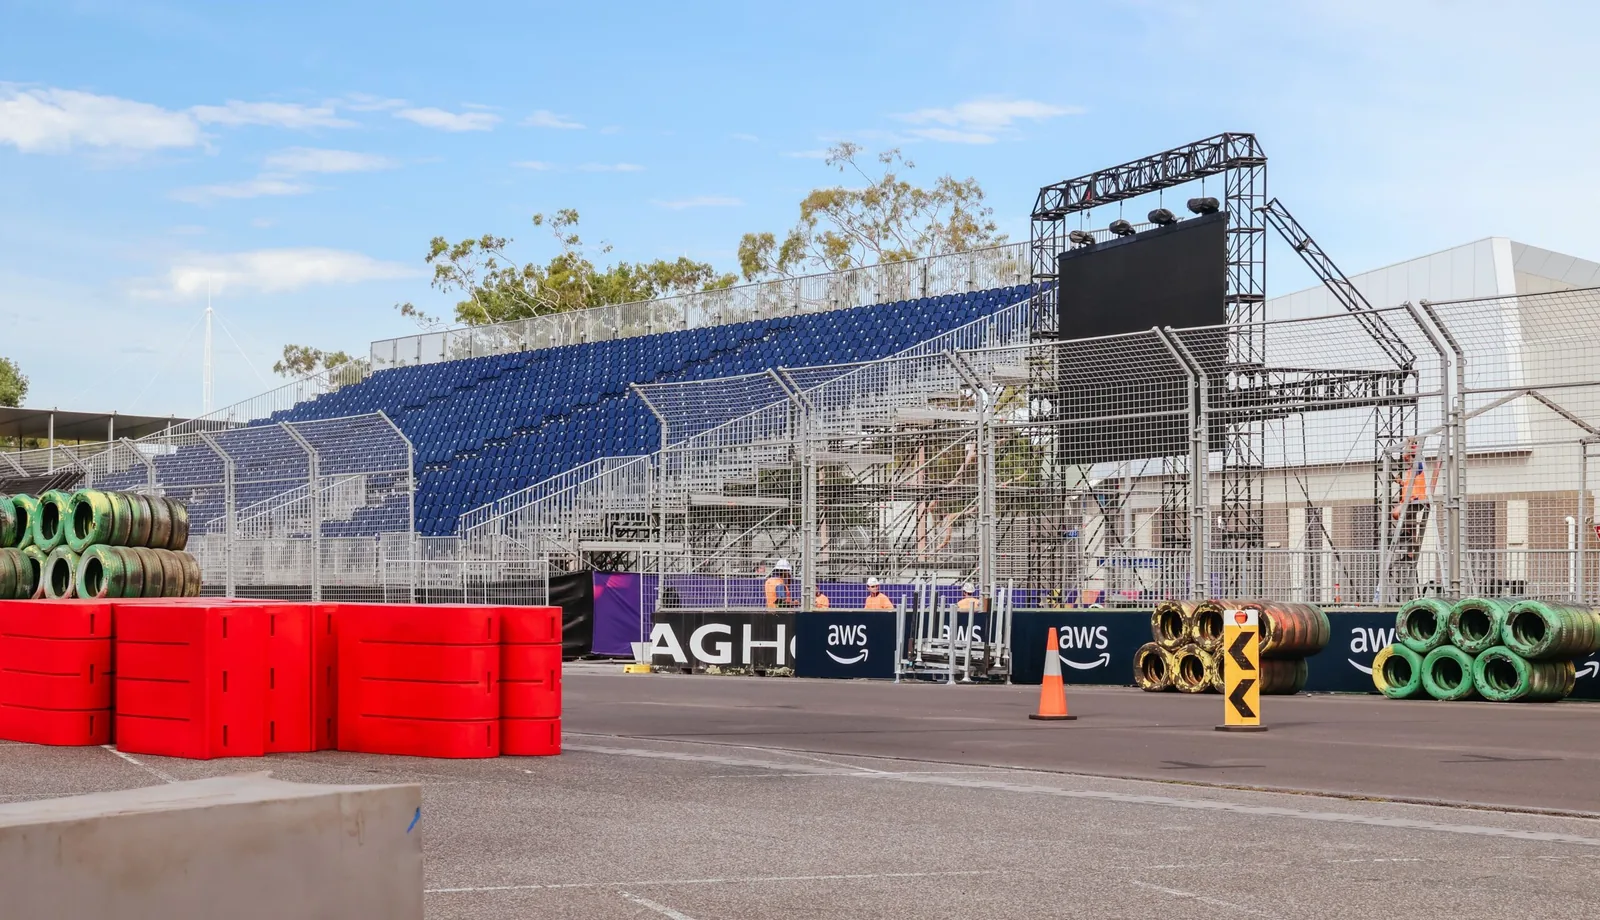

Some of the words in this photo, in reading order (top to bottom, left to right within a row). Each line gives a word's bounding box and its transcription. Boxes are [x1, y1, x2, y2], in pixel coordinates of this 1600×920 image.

[649, 623, 796, 665] AGH
[827, 624, 867, 646] aws
[1059, 625, 1108, 650] aws
[1350, 627, 1401, 653] aw
